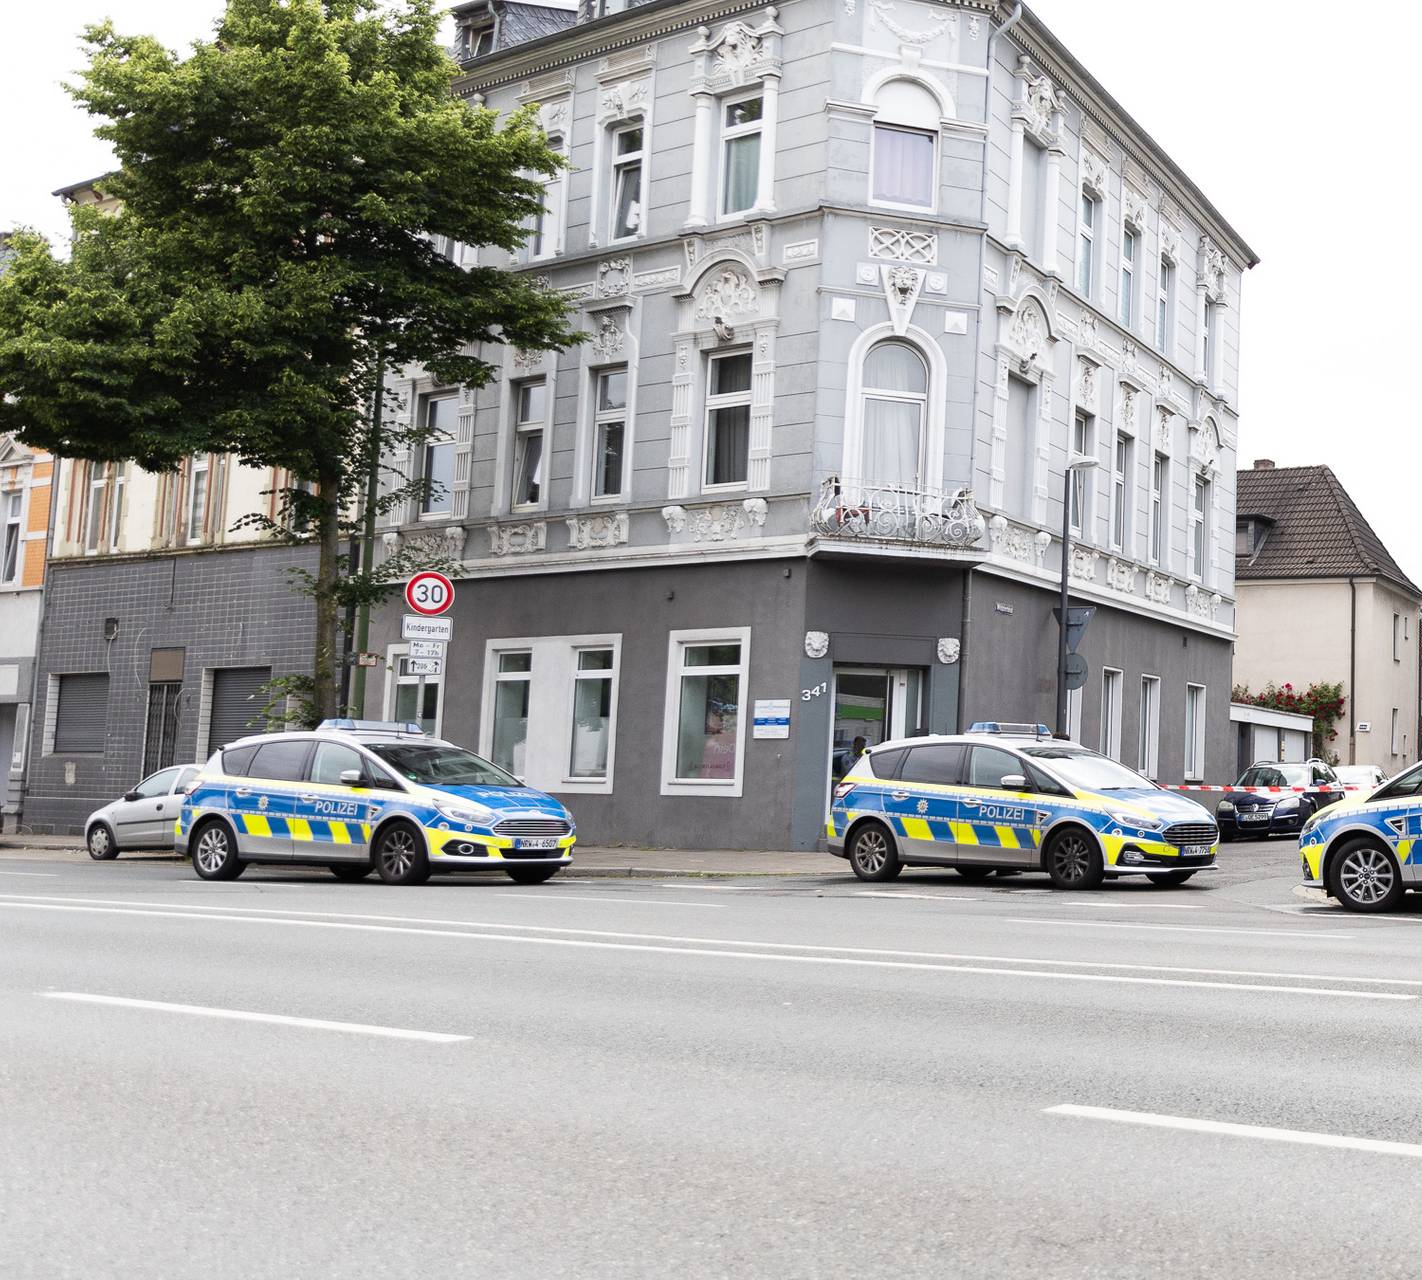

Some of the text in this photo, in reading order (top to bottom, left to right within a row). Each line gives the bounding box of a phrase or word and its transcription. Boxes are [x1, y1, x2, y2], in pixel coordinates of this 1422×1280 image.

[416, 584, 443, 604] 30
[406, 622, 449, 635] Kindergarten
[801, 682, 828, 701] 341
[315, 800, 359, 816] POLIZEI
[978, 805, 1025, 821] POLIZEI
